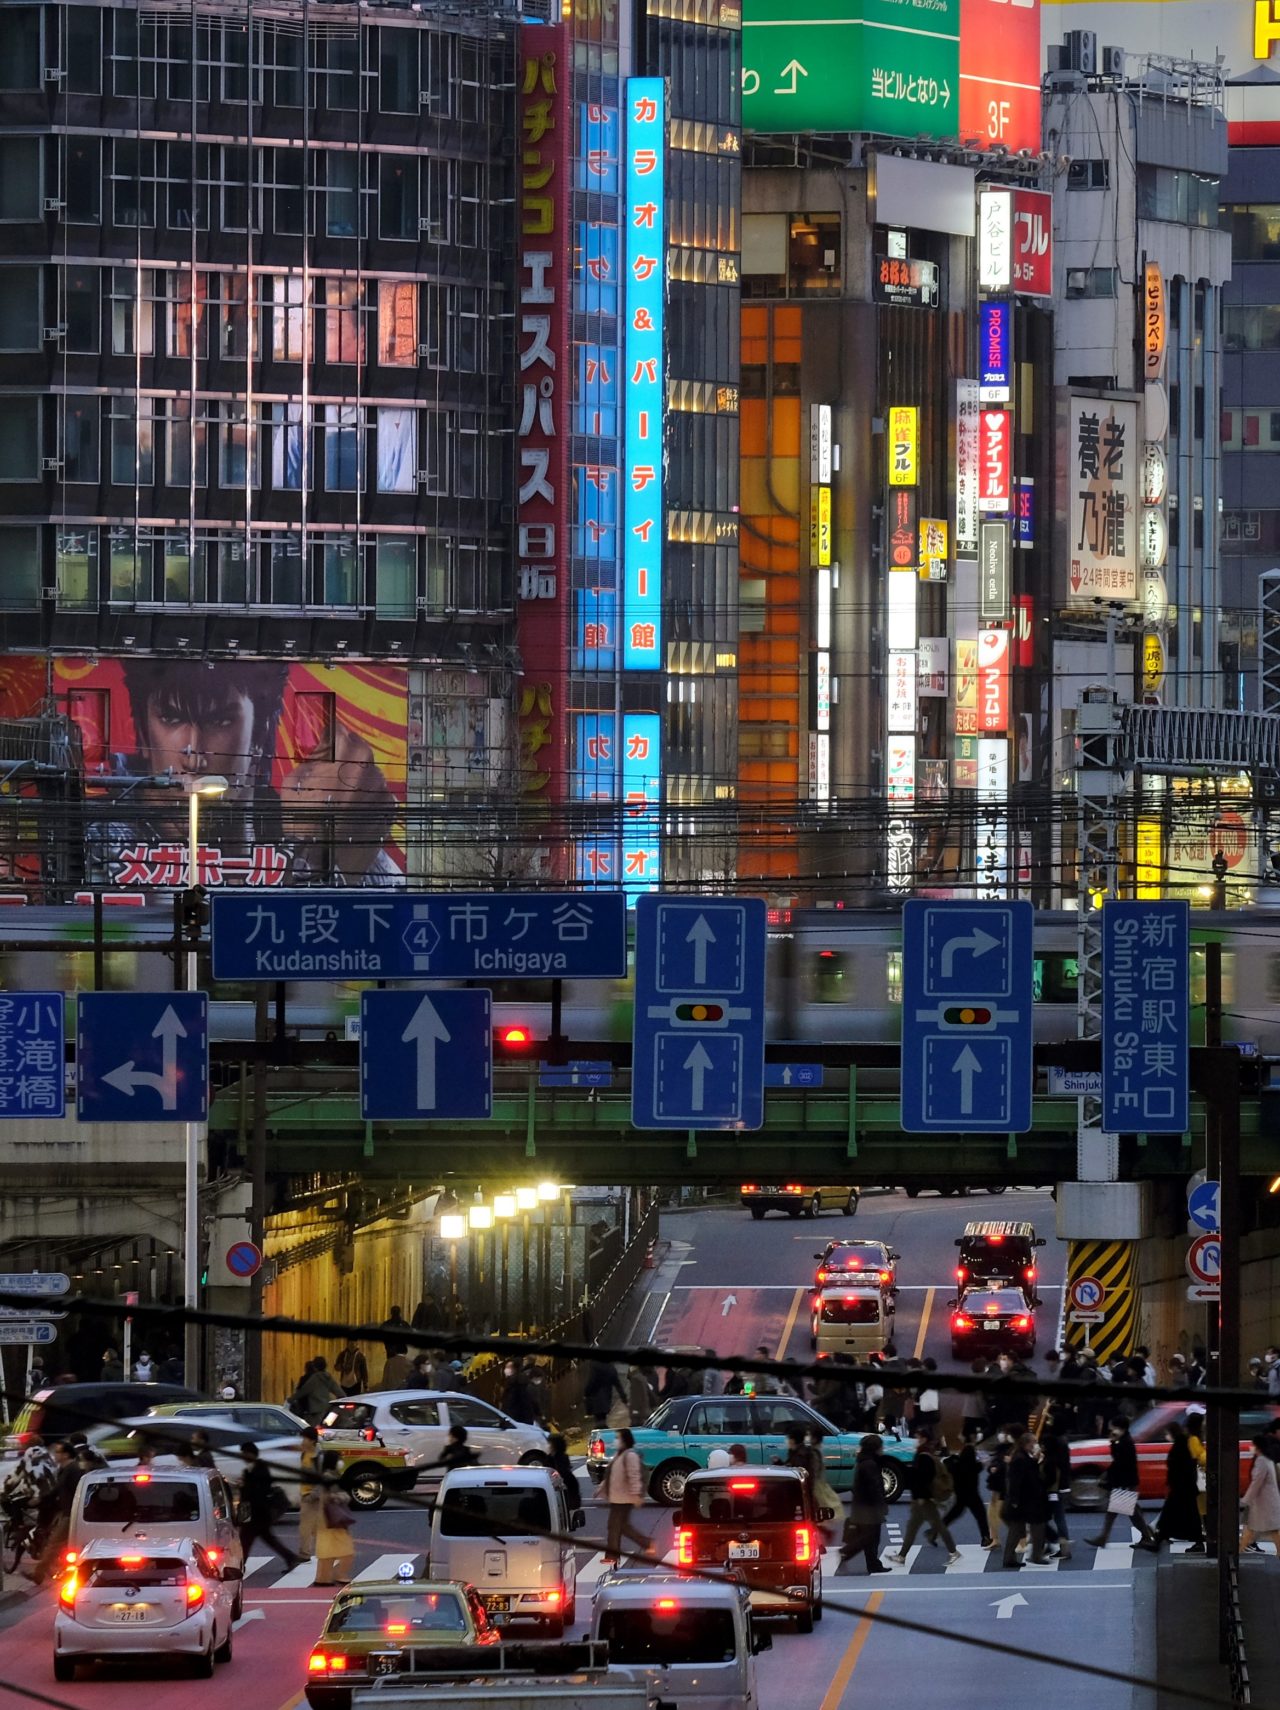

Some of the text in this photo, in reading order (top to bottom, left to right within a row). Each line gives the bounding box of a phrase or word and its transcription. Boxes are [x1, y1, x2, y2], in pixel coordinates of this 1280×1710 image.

[871, 68, 938, 106] 当ビルとなり
[988, 100, 1010, 139] 3F
[986, 200, 1005, 276] 戸谷ビル
[518, 51, 558, 600] パチンコ エスパス日拓
[989, 309, 1001, 368] PROMISE
[631, 97, 657, 649] カラオケ&パーティー館
[988, 390, 1001, 399] 6F
[895, 409, 911, 471] 麻雀ブル
[1078, 411, 1126, 481] 養老
[896, 473, 910, 483] 6F
[986, 430, 1004, 496] アイフル
[988, 500, 1002, 509] 5F
[1082, 568, 1135, 590] 24時間営業中
[985, 669, 1000, 714] アコム
[955, 713, 977, 729] たばこ
[985, 717, 999, 726] 3F
[245, 903, 395, 945] 九段下
[414, 928, 430, 948] 4
[256, 950, 381, 972] Kudanshita
[474, 950, 567, 972] Ichigaya
[1109, 919, 1138, 1022] Shinjuku
[1141, 913, 1178, 1118] 新宿駅東口
[16, 1000, 58, 1110] 小滝橋
[1064, 1080, 1102, 1091] Shinjuk
